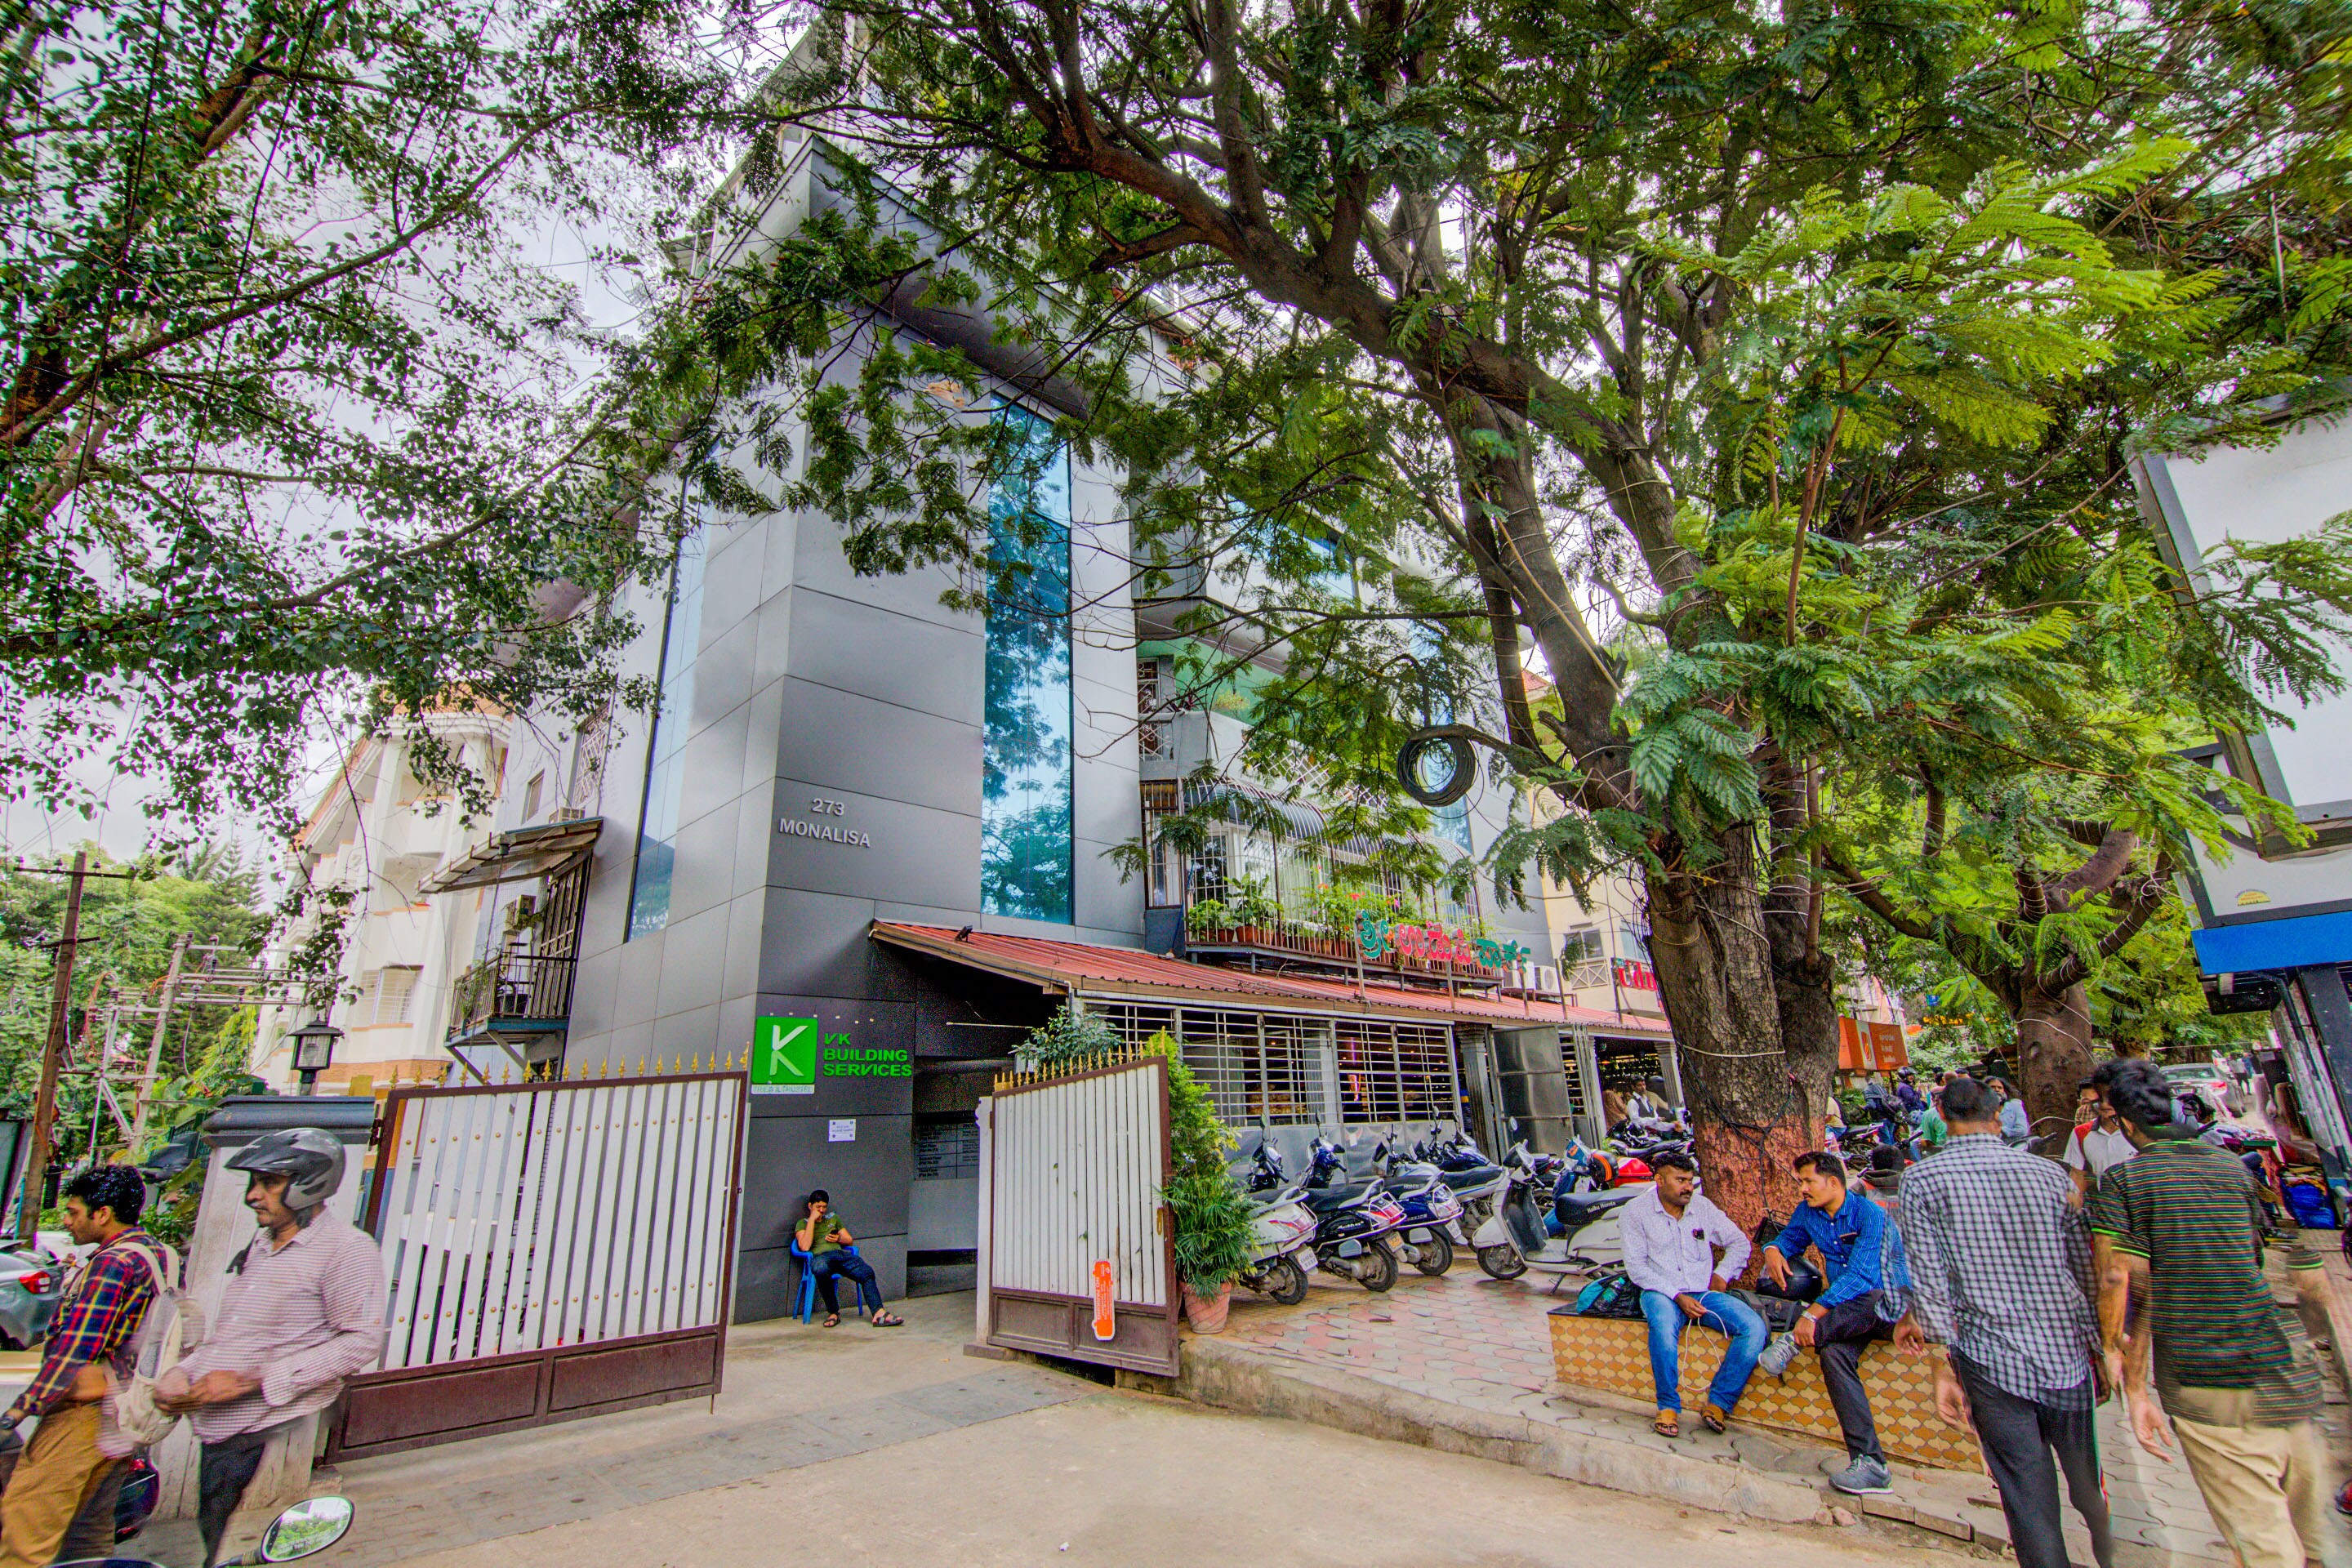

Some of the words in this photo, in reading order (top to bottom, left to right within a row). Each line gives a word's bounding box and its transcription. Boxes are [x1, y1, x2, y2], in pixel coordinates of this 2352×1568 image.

[811, 797, 844, 817] 273
[778, 817, 871, 848] MONALISA
[823, 1032, 851, 1046] VK
[822, 1049, 908, 1062] BUILDING
[822, 1063, 912, 1077] SERVICES
